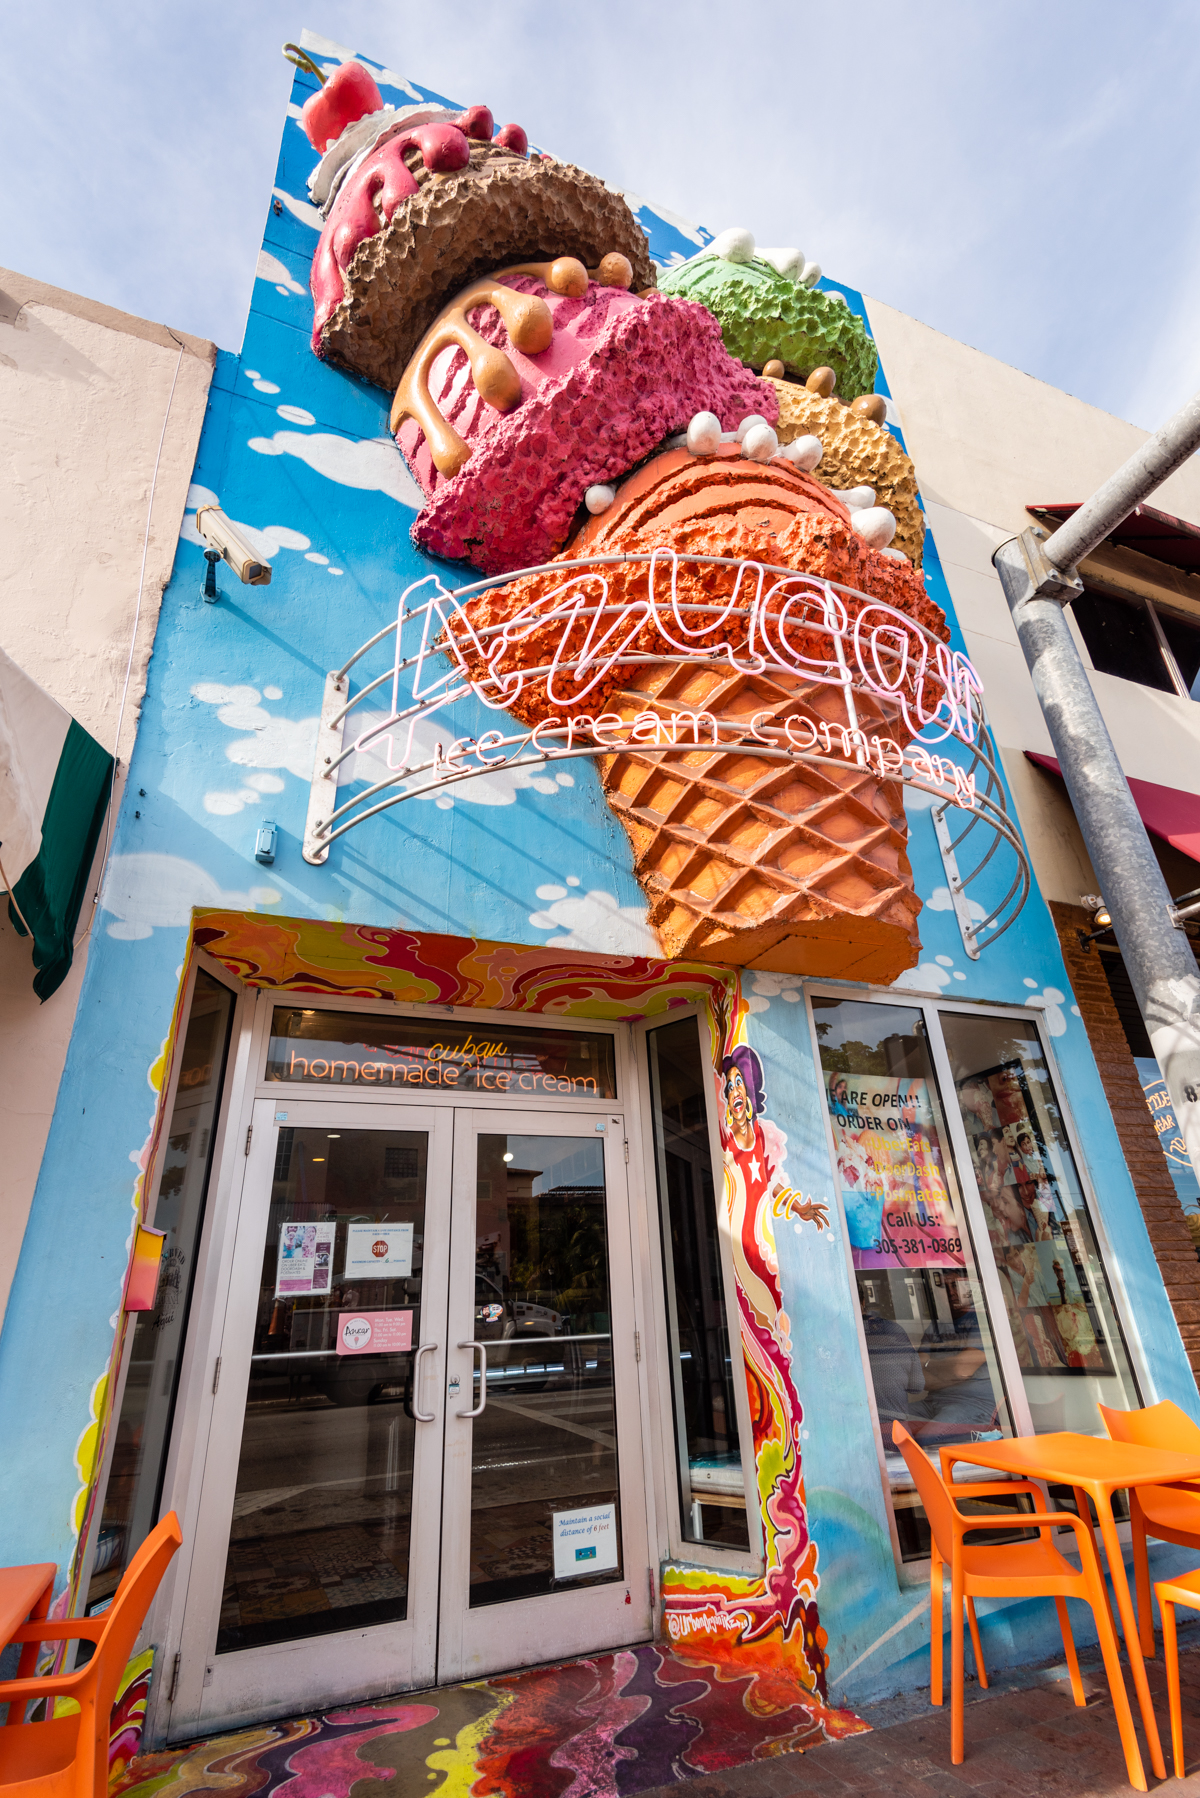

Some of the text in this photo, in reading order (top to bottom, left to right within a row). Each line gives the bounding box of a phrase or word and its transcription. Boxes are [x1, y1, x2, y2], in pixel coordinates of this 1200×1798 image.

[432, 711, 976, 809] ice cream company
[290, 1050, 459, 1086] homemade
[475, 1066, 511, 1090] ice
[518, 1071, 598, 1095] cream
[841, 1090, 868, 1106] ARE
[872, 1093, 922, 1108] OPEN!!
[836, 1113, 911, 1131] ORDER ON
[886, 1212, 941, 1228] Call Us:
[373, 1245, 388, 1253] STOP
[873, 1238, 963, 1255] 305-381-0369
[558, 1516, 587, 1526] Maintain
[594, 1511, 611, 1521] social
[560, 1528, 585, 1537] distance
[586, 1524, 593, 1534] of
[598, 1523, 609, 1533] feet
